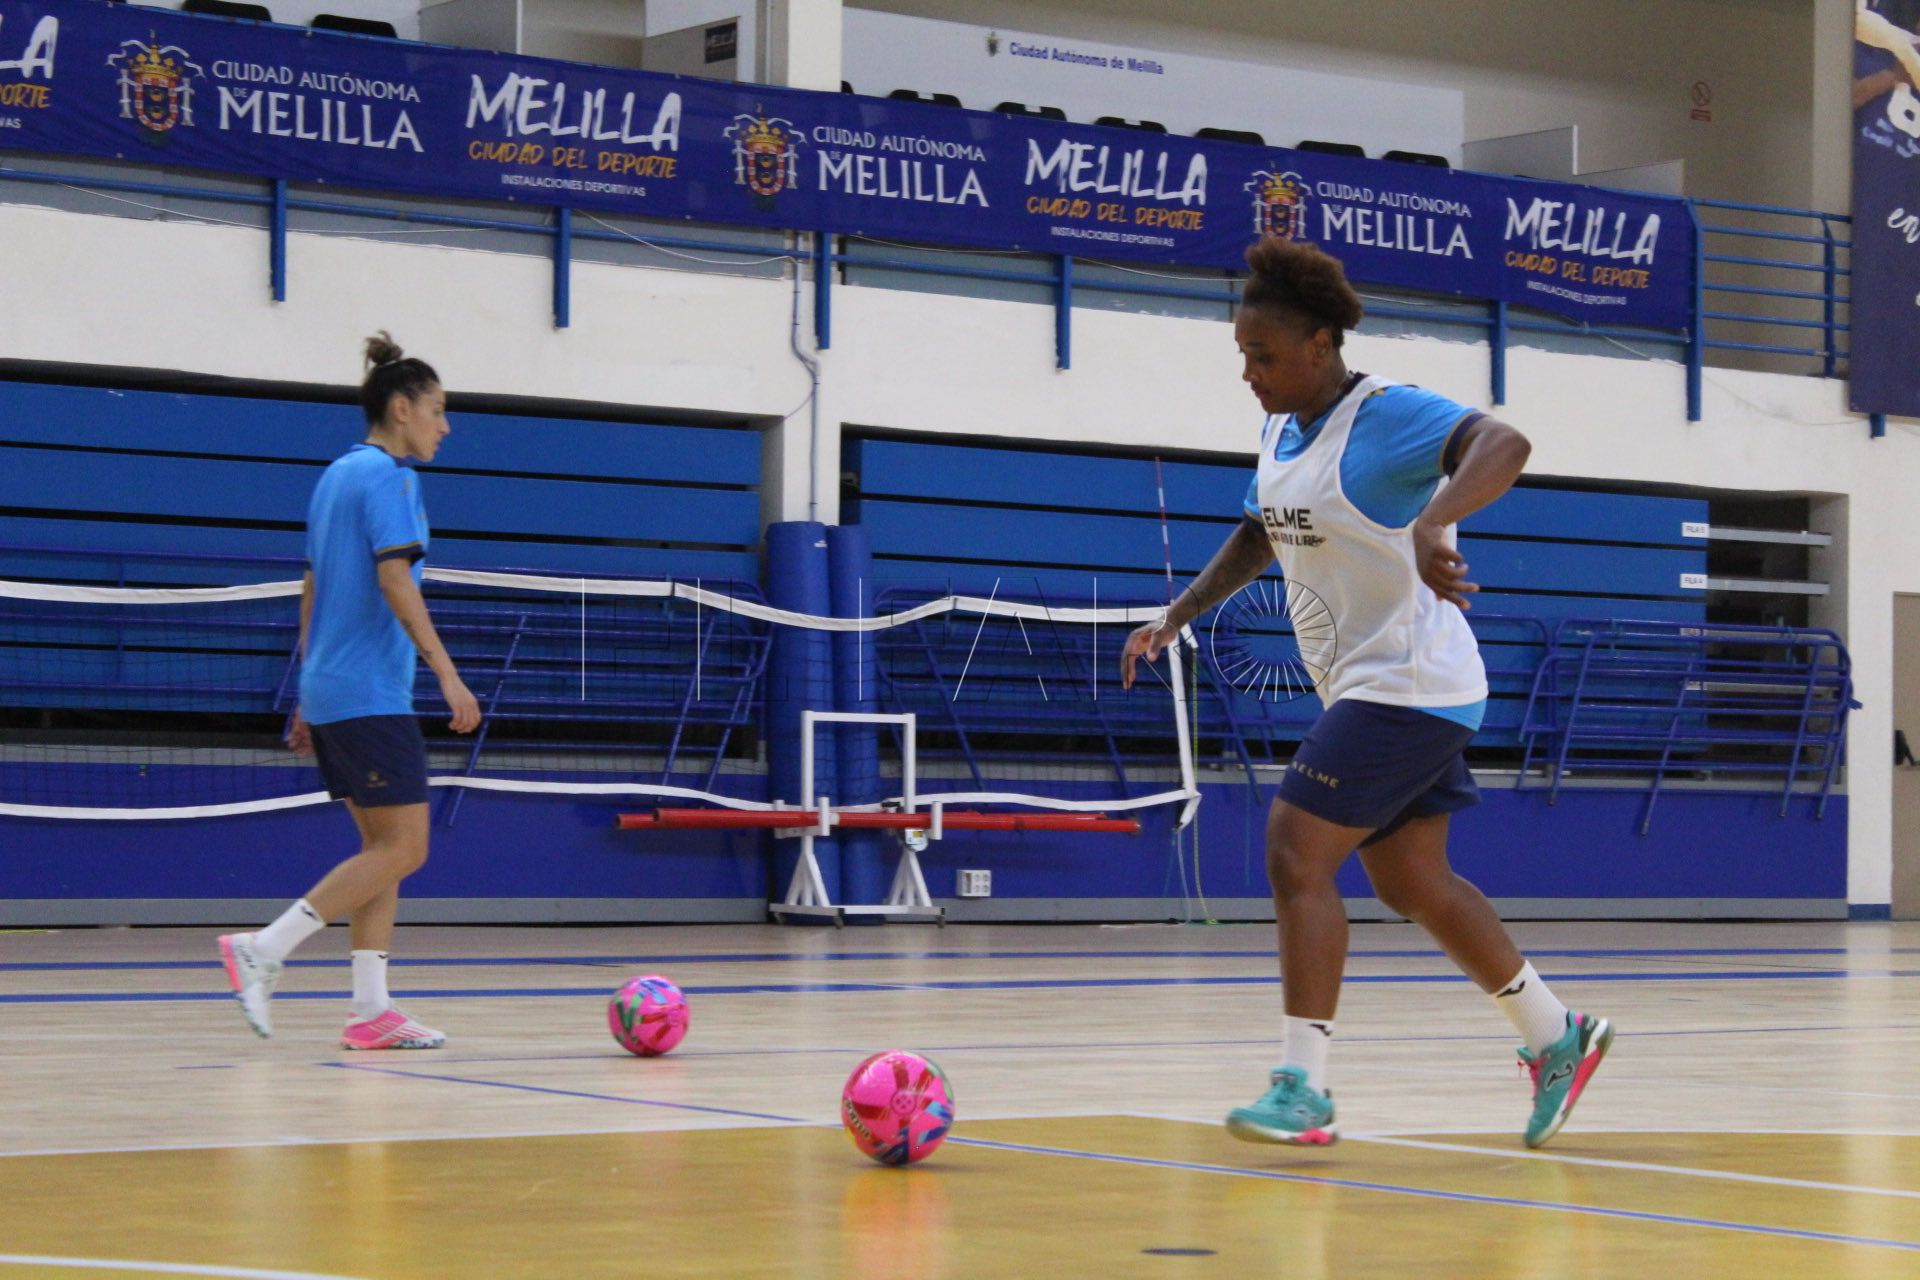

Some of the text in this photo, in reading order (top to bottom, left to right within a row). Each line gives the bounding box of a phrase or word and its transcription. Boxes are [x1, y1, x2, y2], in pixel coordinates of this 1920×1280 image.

[1010, 42, 1048, 59] Ciudad
[1110, 56, 1124, 69] de
[0, 83, 51, 108] ORTE
[212, 60, 421, 103] CIUDAD AUTÓNOMA
[233, 87, 247, 98] DE
[217, 85, 424, 153] MELILLA
[465, 71, 682, 152] MELILLA
[468, 139, 678, 179] CIUDAD DEL DEPORTE
[812, 126, 987, 162] CIUDAD AUTÓNOMA
[501, 174, 647, 197] INSTALACIONES DEPORTIVAS
[817, 149, 990, 208] MELILLA
[1024, 138, 1208, 206] MELILLA
[1026, 196, 1205, 231] CIUDAD DEL DEPORTE
[1316, 181, 1472, 218] CIUDAD AUTÓNOMA
[1050, 226, 1175, 247] INSTALACIONES DEPORTIVAS
[1321, 203, 1474, 260] MELILLA
[1504, 197, 1661, 265] MELILLA
[1505, 251, 1651, 289] CIUDAD DEL DEPORTE
[1261, 507, 1313, 530] ELME
